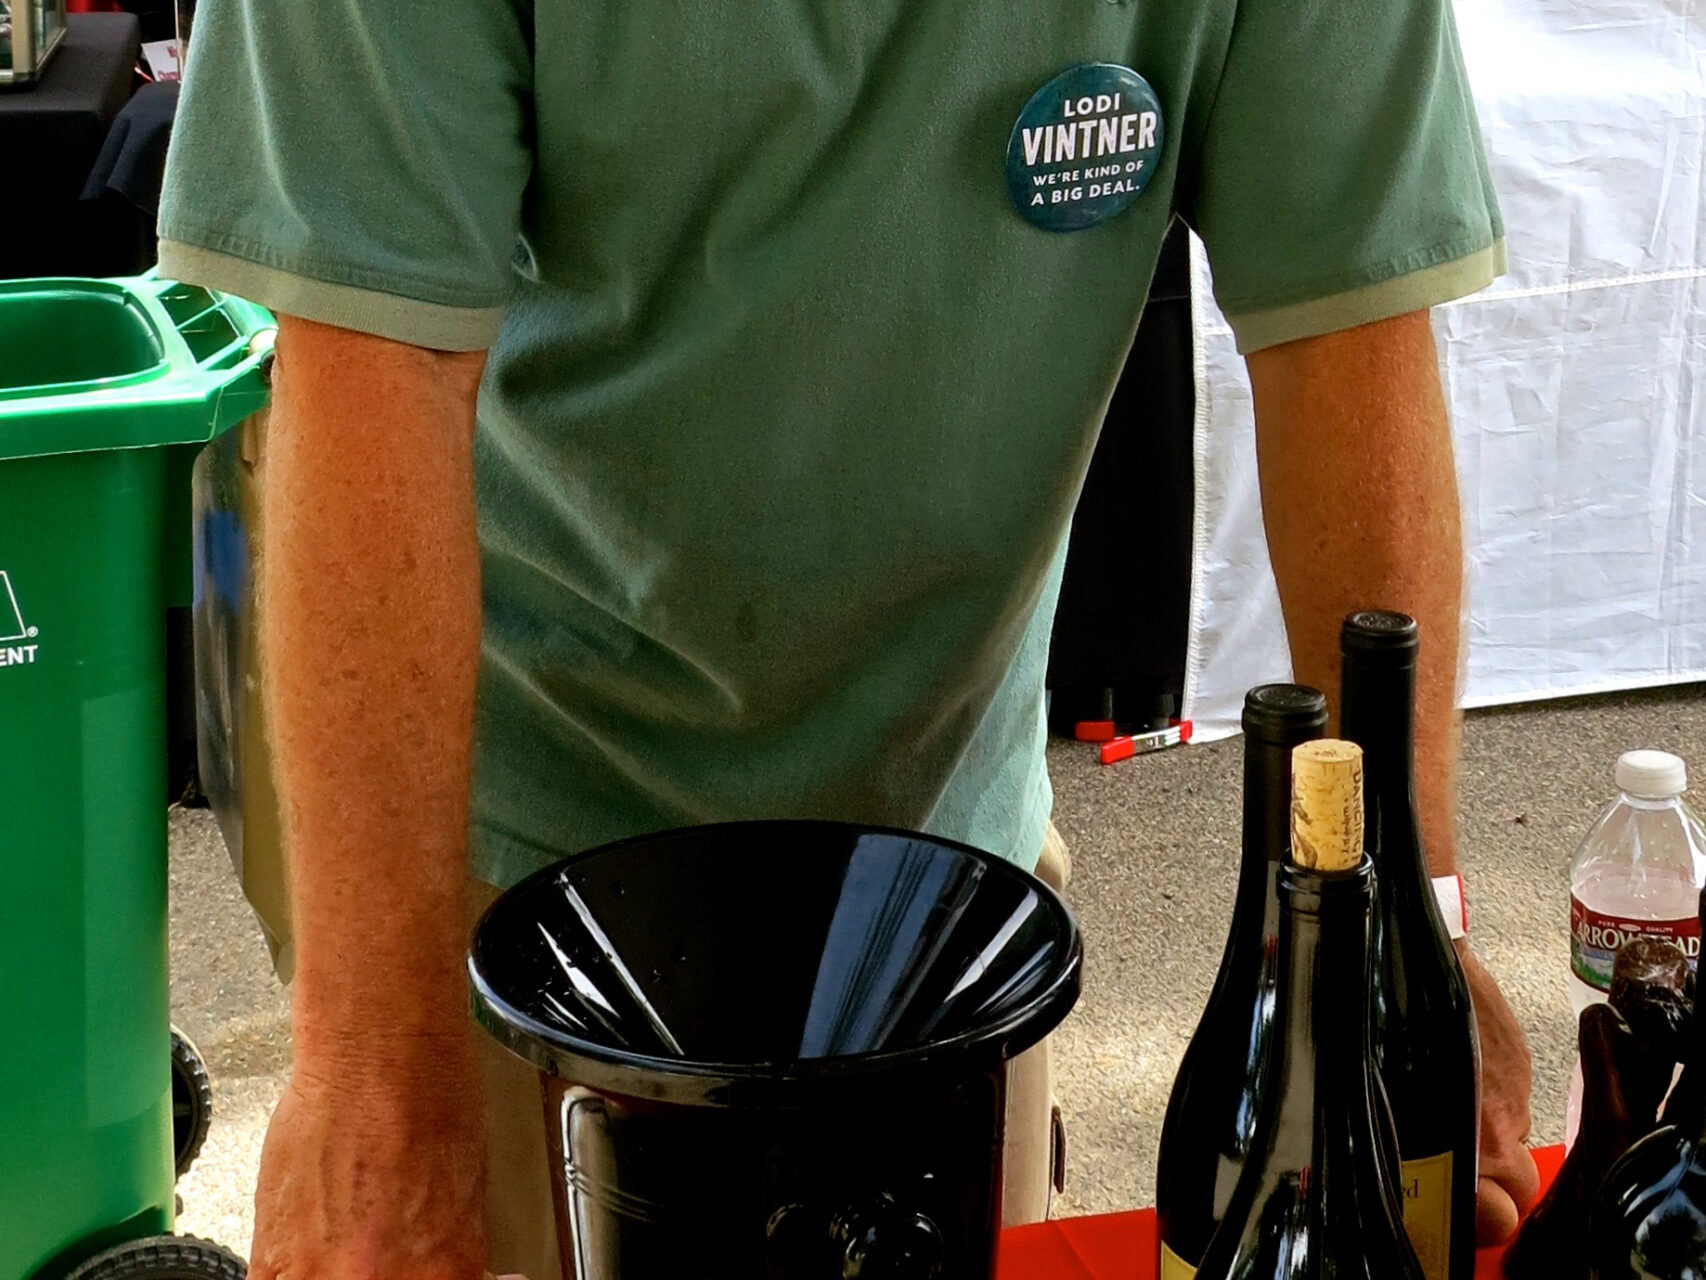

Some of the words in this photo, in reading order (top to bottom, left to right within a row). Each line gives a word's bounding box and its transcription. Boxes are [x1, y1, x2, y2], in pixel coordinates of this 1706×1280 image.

[1064, 93, 1120, 117] LODI
[1022, 111, 1157, 166] VINTNER
[1033, 170, 1080, 186] WE'RE
[1084, 164, 1121, 180] KIND
[1125, 160, 1145, 173] OF
[1031, 193, 1044, 206] A
[1051, 187, 1083, 204] BIG
[1089, 179, 1140, 198] DEAL.
